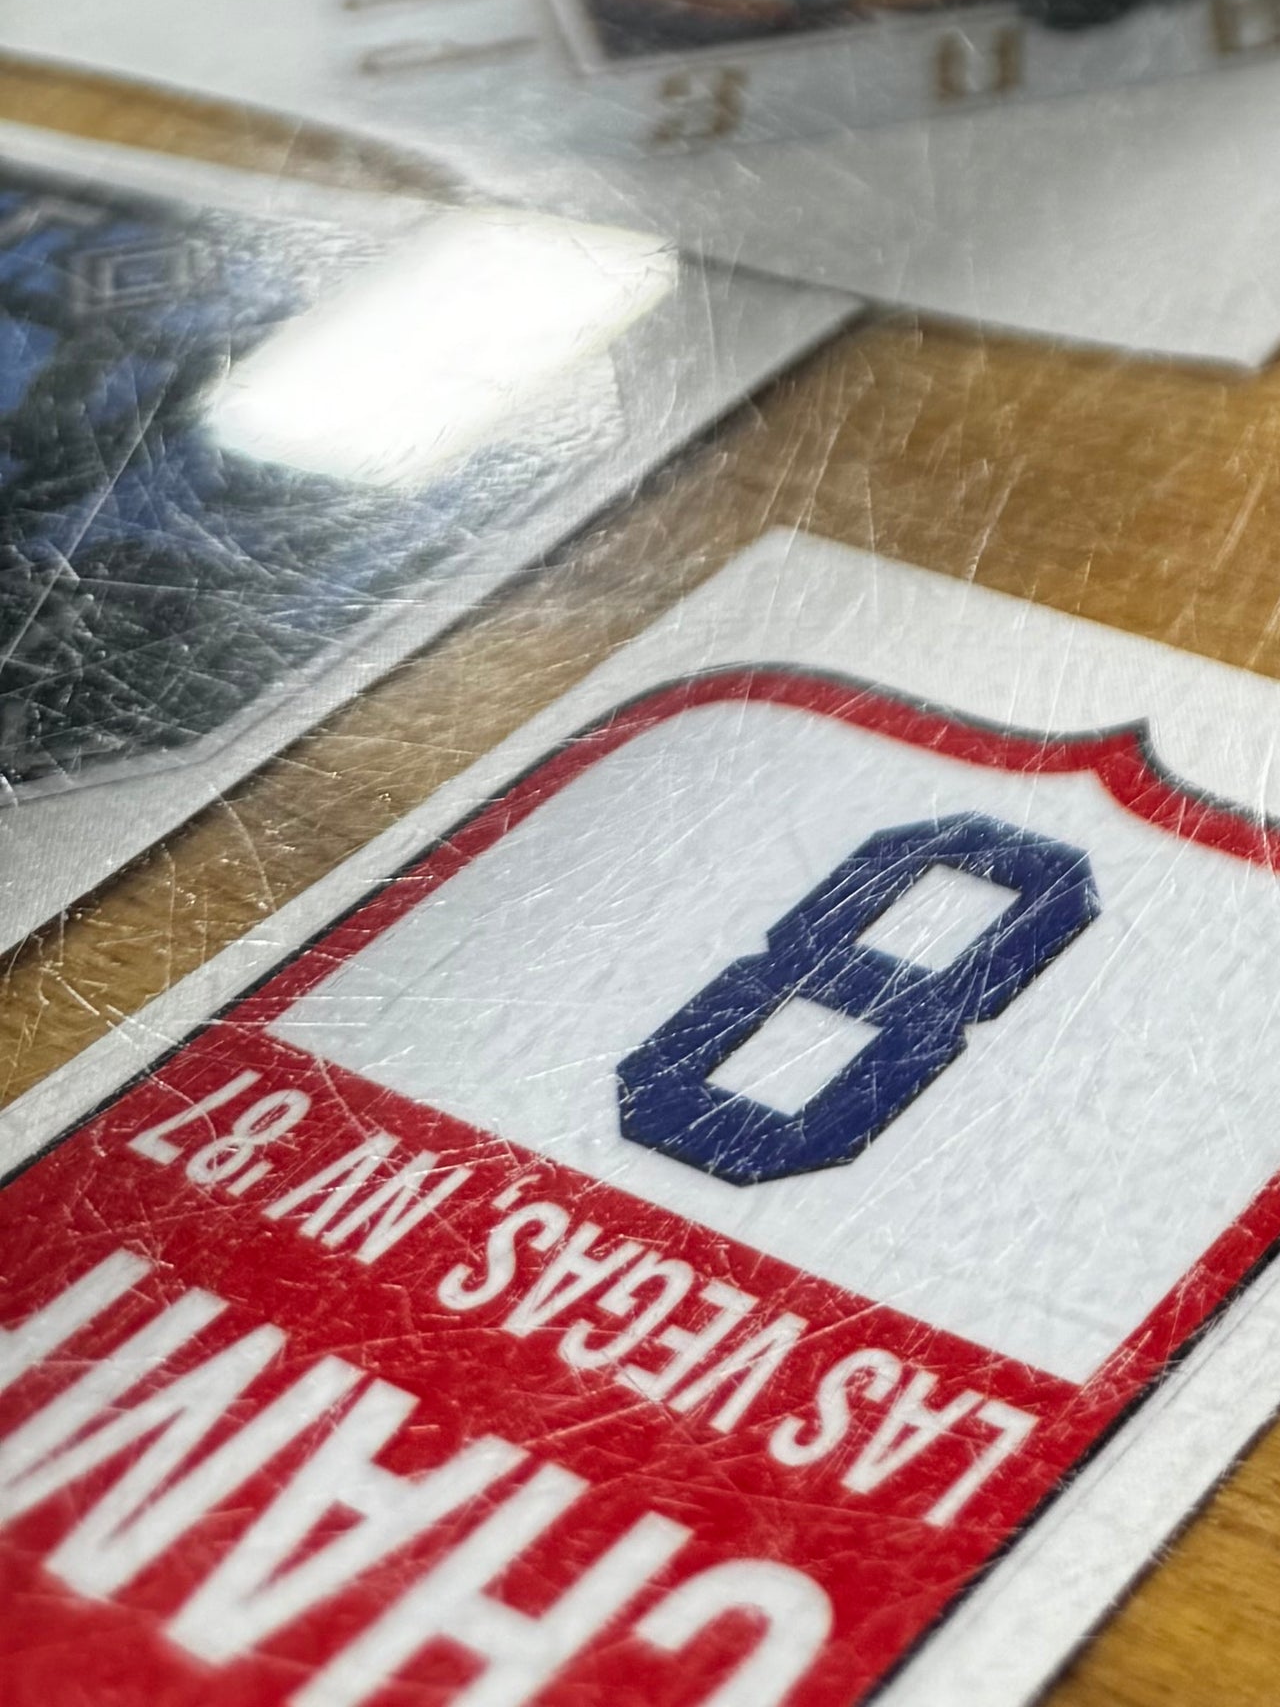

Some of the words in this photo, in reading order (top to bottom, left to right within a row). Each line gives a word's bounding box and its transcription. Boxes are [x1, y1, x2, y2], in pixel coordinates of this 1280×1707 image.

[617, 811, 1103, 1188] 8
[126, 1067, 312, 1199] '87
[267, 1124, 472, 1264] NV
[440, 1179, 808, 1432] VEGAS,
[770, 1349, 1039, 1527] LAS
